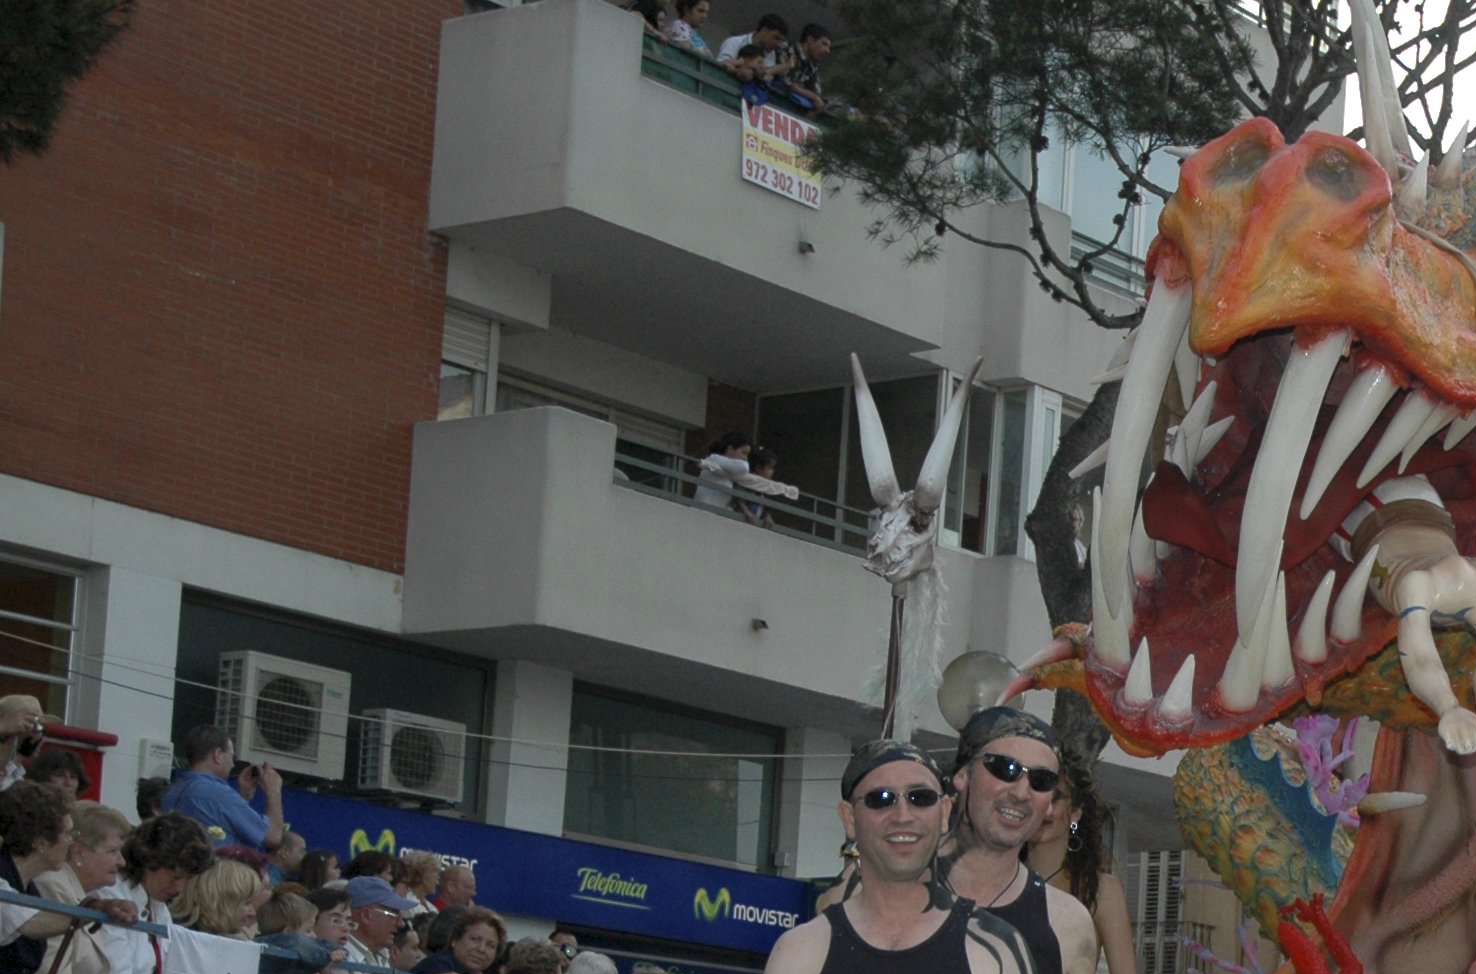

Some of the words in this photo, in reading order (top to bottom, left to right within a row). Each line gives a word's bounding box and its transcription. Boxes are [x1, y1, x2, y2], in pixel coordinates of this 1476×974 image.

[746, 158, 768, 184] 972
[771, 168, 794, 195] 302
[798, 180, 819, 205] 102
[732, 903, 799, 929] movistar
